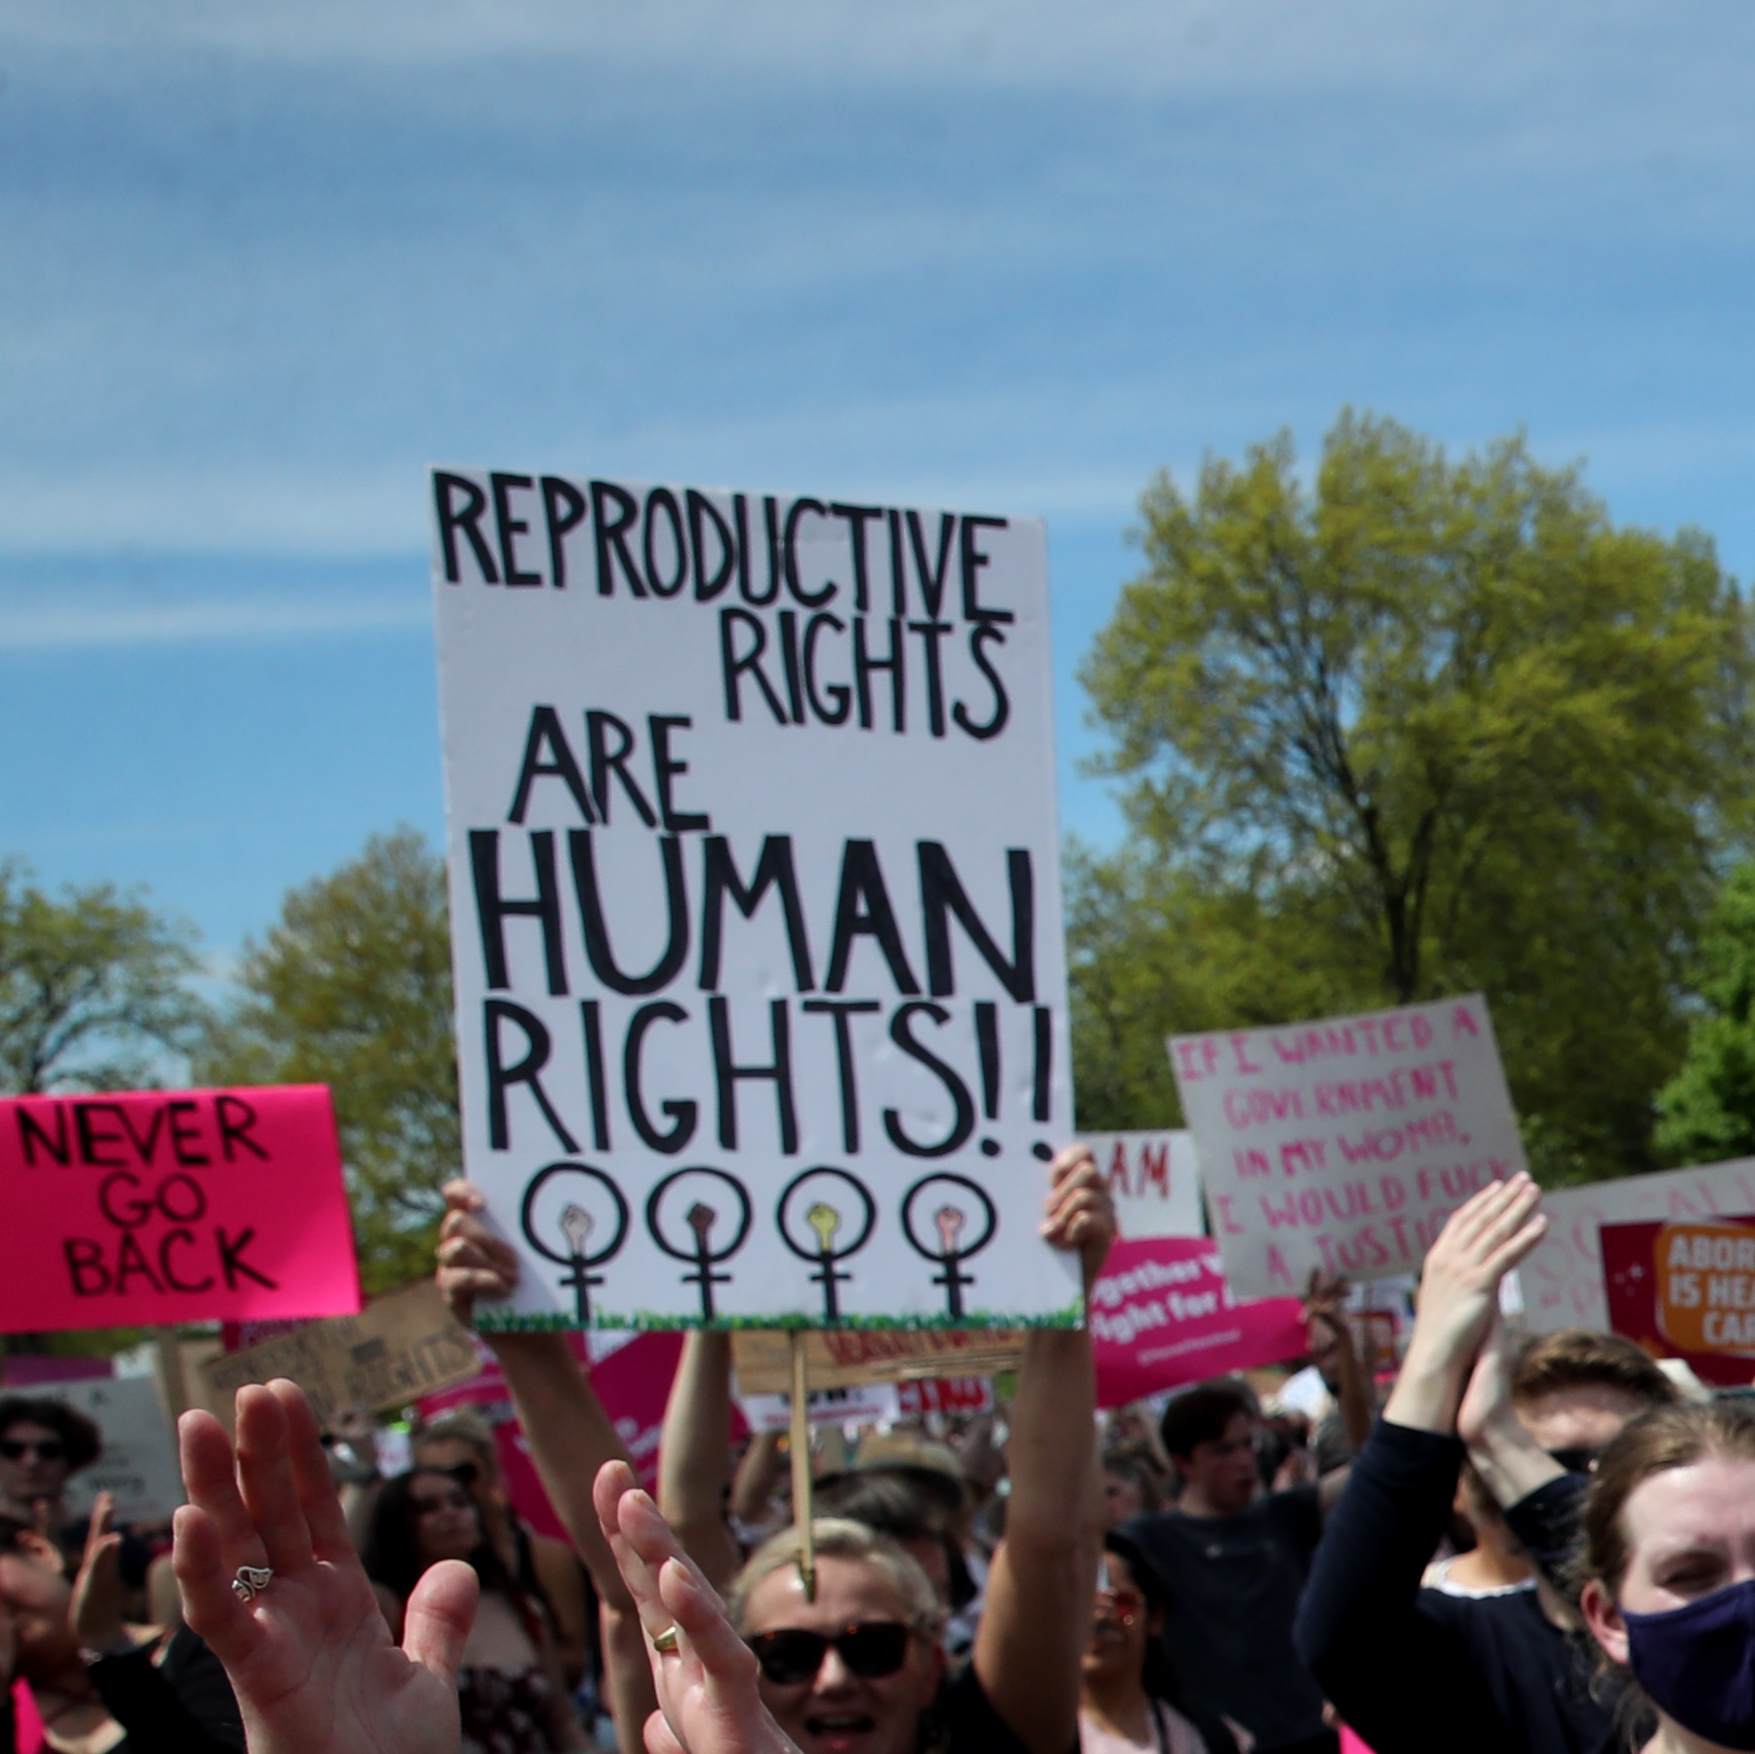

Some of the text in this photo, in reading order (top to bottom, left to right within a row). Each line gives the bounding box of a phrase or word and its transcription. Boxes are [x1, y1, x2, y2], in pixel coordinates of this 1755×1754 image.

[432, 470, 1014, 625] REPRODUCTIVE
[720, 608, 1009, 740] RIGHTS
[508, 706, 711, 832] ARE
[468, 829, 1036, 1004] HUMAN
[483, 997, 1053, 1162] RIGHTS!!
[1178, 1005, 1481, 1082] IF I WANTED A
[15, 1097, 270, 1167] NEVER
[1223, 1060, 1458, 1130] GOVERNMENT
[1233, 1149, 1270, 1178] IN
[1279, 1139, 1325, 1177] MY
[98, 1169, 208, 1228] GO
[1216, 1196, 1244, 1234] I
[1258, 1176, 1406, 1229] WOULD
[64, 1226, 279, 1297] BACK
[1266, 1245, 1292, 1286] A
[1316, 1208, 1452, 1277] JUSTIC
[1670, 1274, 1701, 1307] IS
